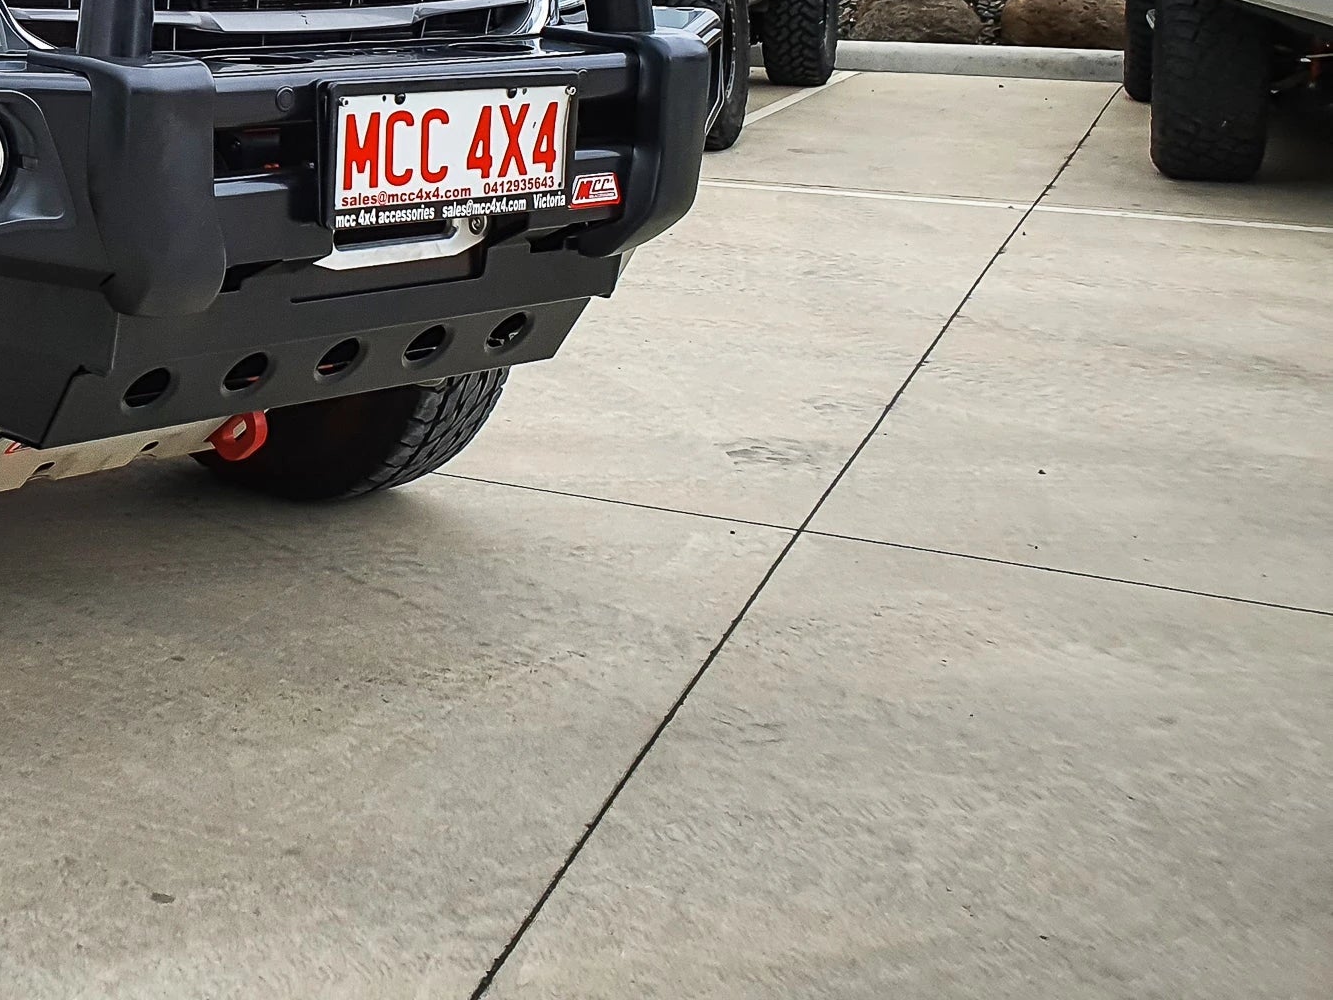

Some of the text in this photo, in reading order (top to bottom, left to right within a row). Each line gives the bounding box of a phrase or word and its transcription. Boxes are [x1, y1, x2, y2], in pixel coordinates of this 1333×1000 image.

[343, 102, 559, 190] MCC 4X4
[335, 190, 566, 228] mcc 4x4 accessories sales@mcc4x4.com Victoria
[341, 176, 556, 207] sales@mcc4x4.com 0412935643
